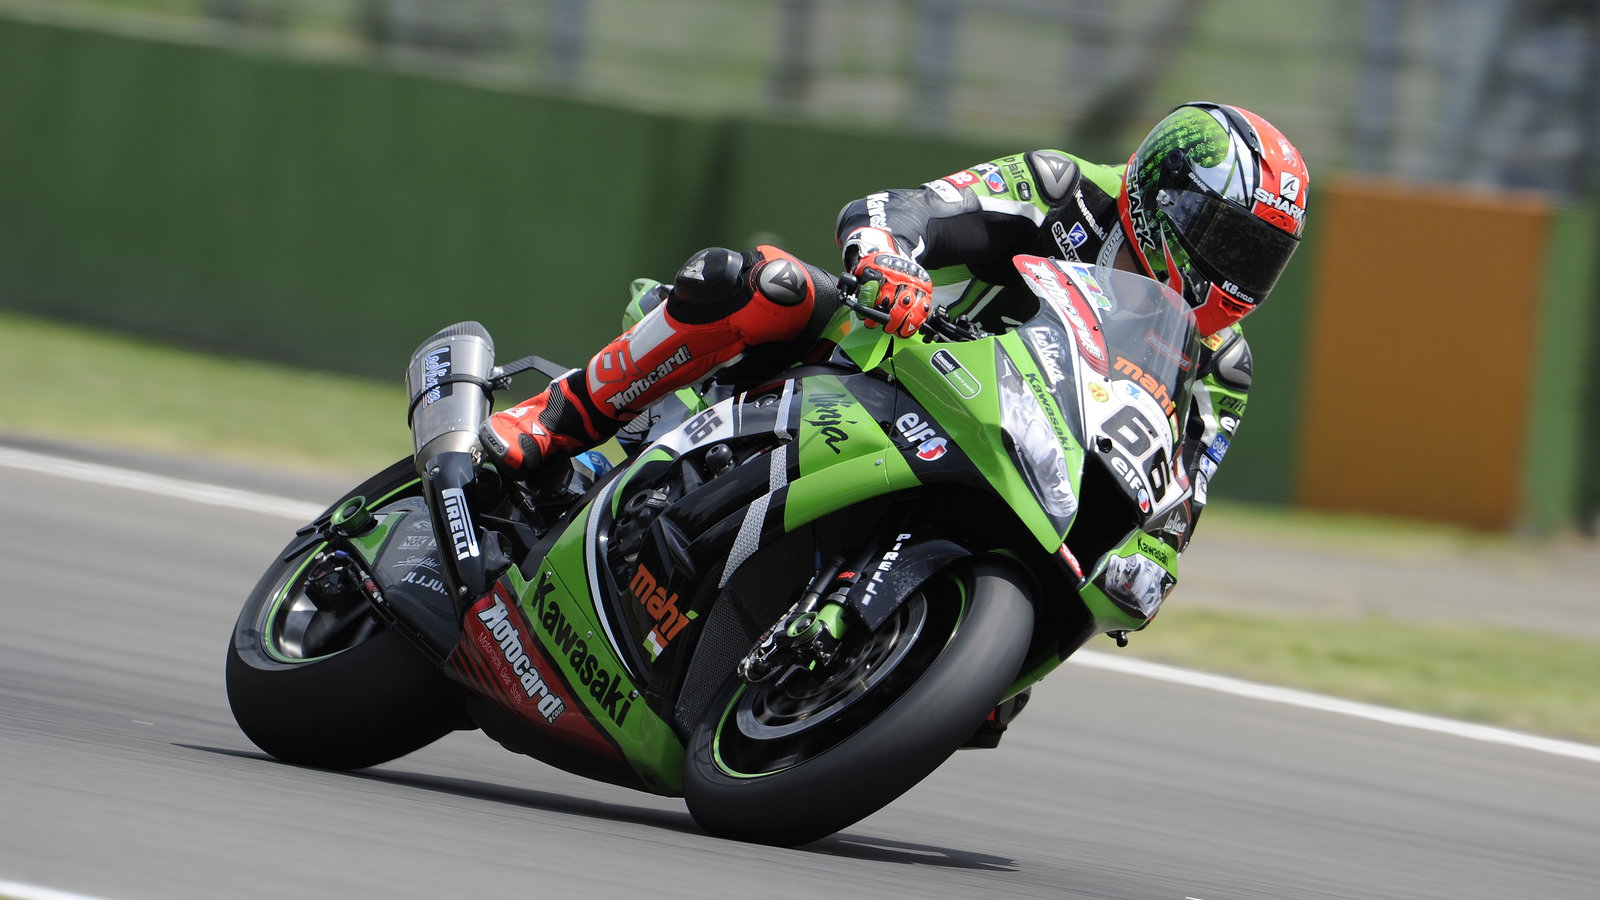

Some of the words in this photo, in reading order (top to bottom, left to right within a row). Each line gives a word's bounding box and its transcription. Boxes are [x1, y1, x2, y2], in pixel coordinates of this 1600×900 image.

[1127, 157, 1156, 251] SHARK
[1188, 172, 1211, 192] SHARK
[1254, 187, 1305, 222] SHARK
[1075, 189, 1107, 241] Kawasaki
[1221, 281, 1239, 296] KB
[684, 408, 722, 445] 66
[802, 393, 858, 455] Ninja
[896, 412, 936, 443] elf
[1025, 373, 1075, 451] Kawasaki
[1101, 405, 1171, 503] 66
[1111, 457, 1143, 490] elf
[400, 536, 429, 547] NGK
[442, 488, 480, 560] PIRELLI
[1137, 537, 1169, 567] Kawasaki
[861, 533, 912, 606] PIRELLI
[629, 563, 699, 641] mahi
[478, 632, 501, 669] Motorcycle
[500, 666, 512, 685] Gear
[510, 684, 522, 704] Store
[532, 573, 636, 728] Kawasaki
